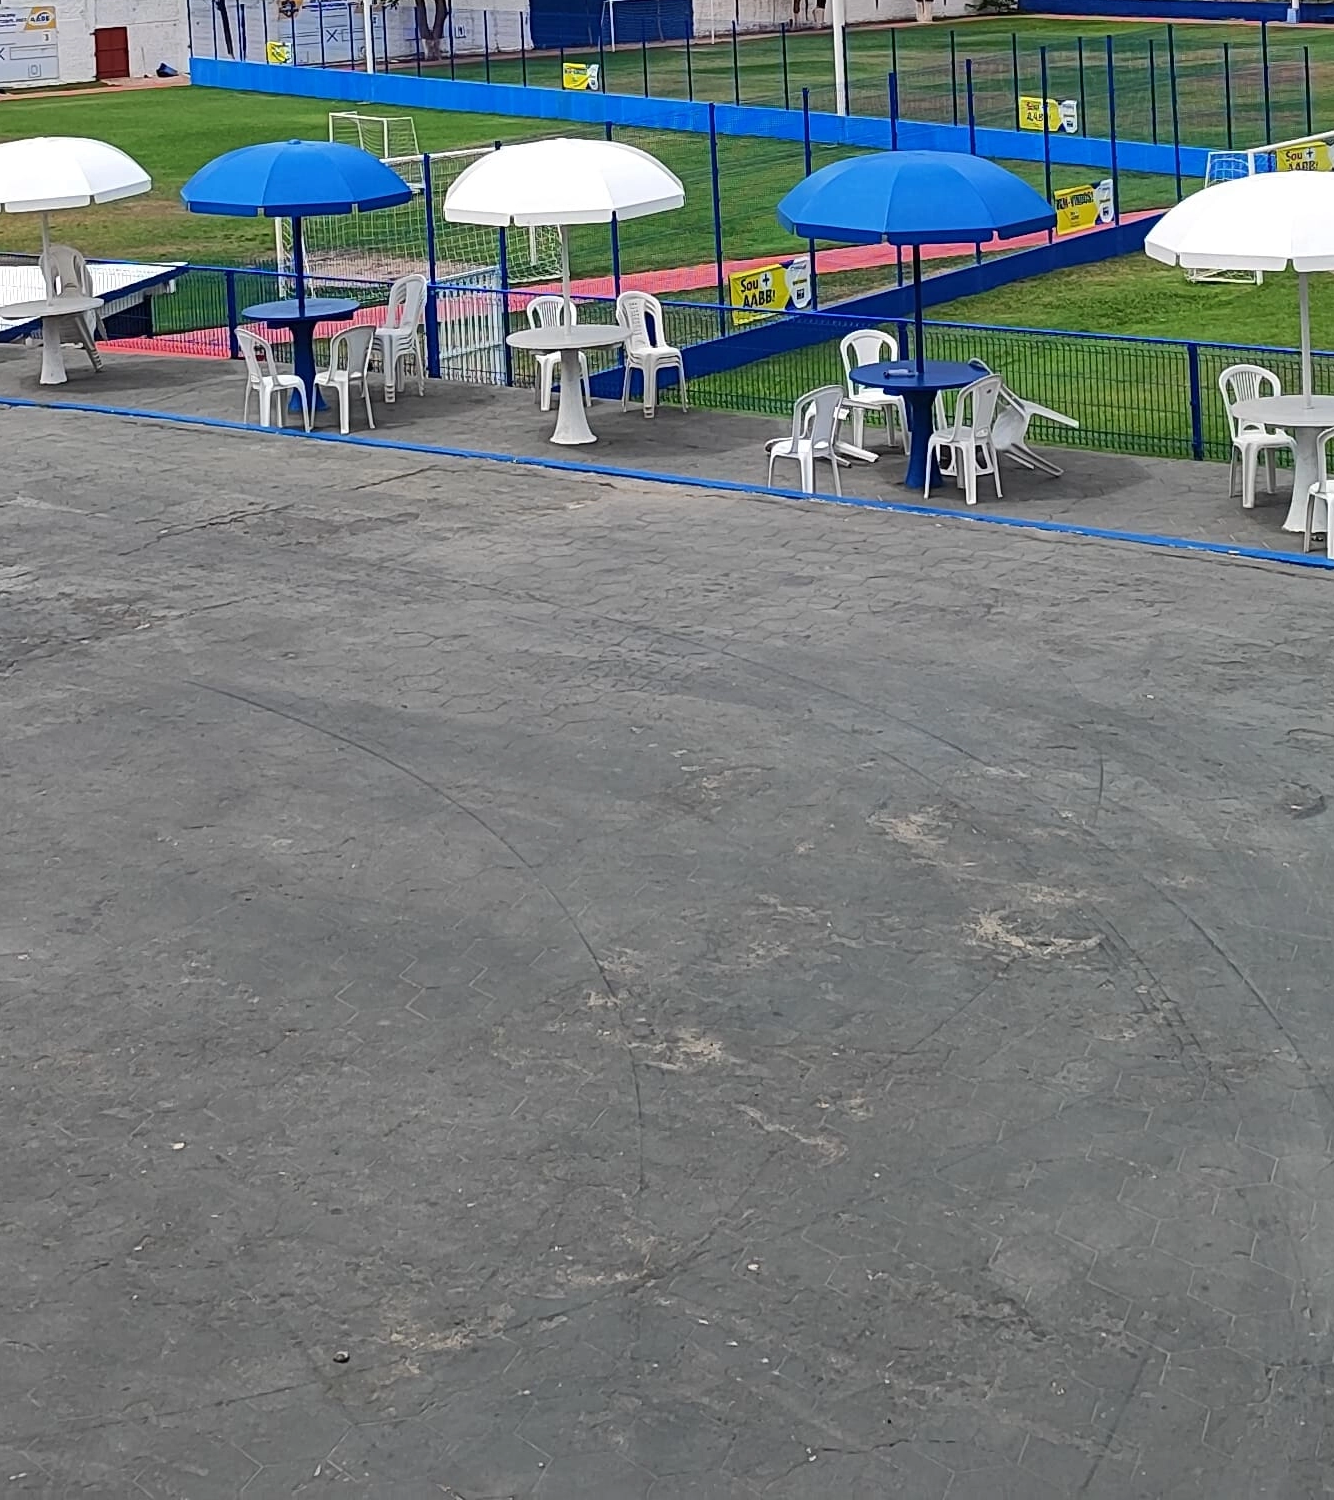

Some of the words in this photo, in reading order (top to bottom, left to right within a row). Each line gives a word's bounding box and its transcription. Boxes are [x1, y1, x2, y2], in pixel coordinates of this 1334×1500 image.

[1285, 151, 1303, 162] Sou
[740, 277, 758, 293] Sou
[743, 289, 776, 308] AABB!
